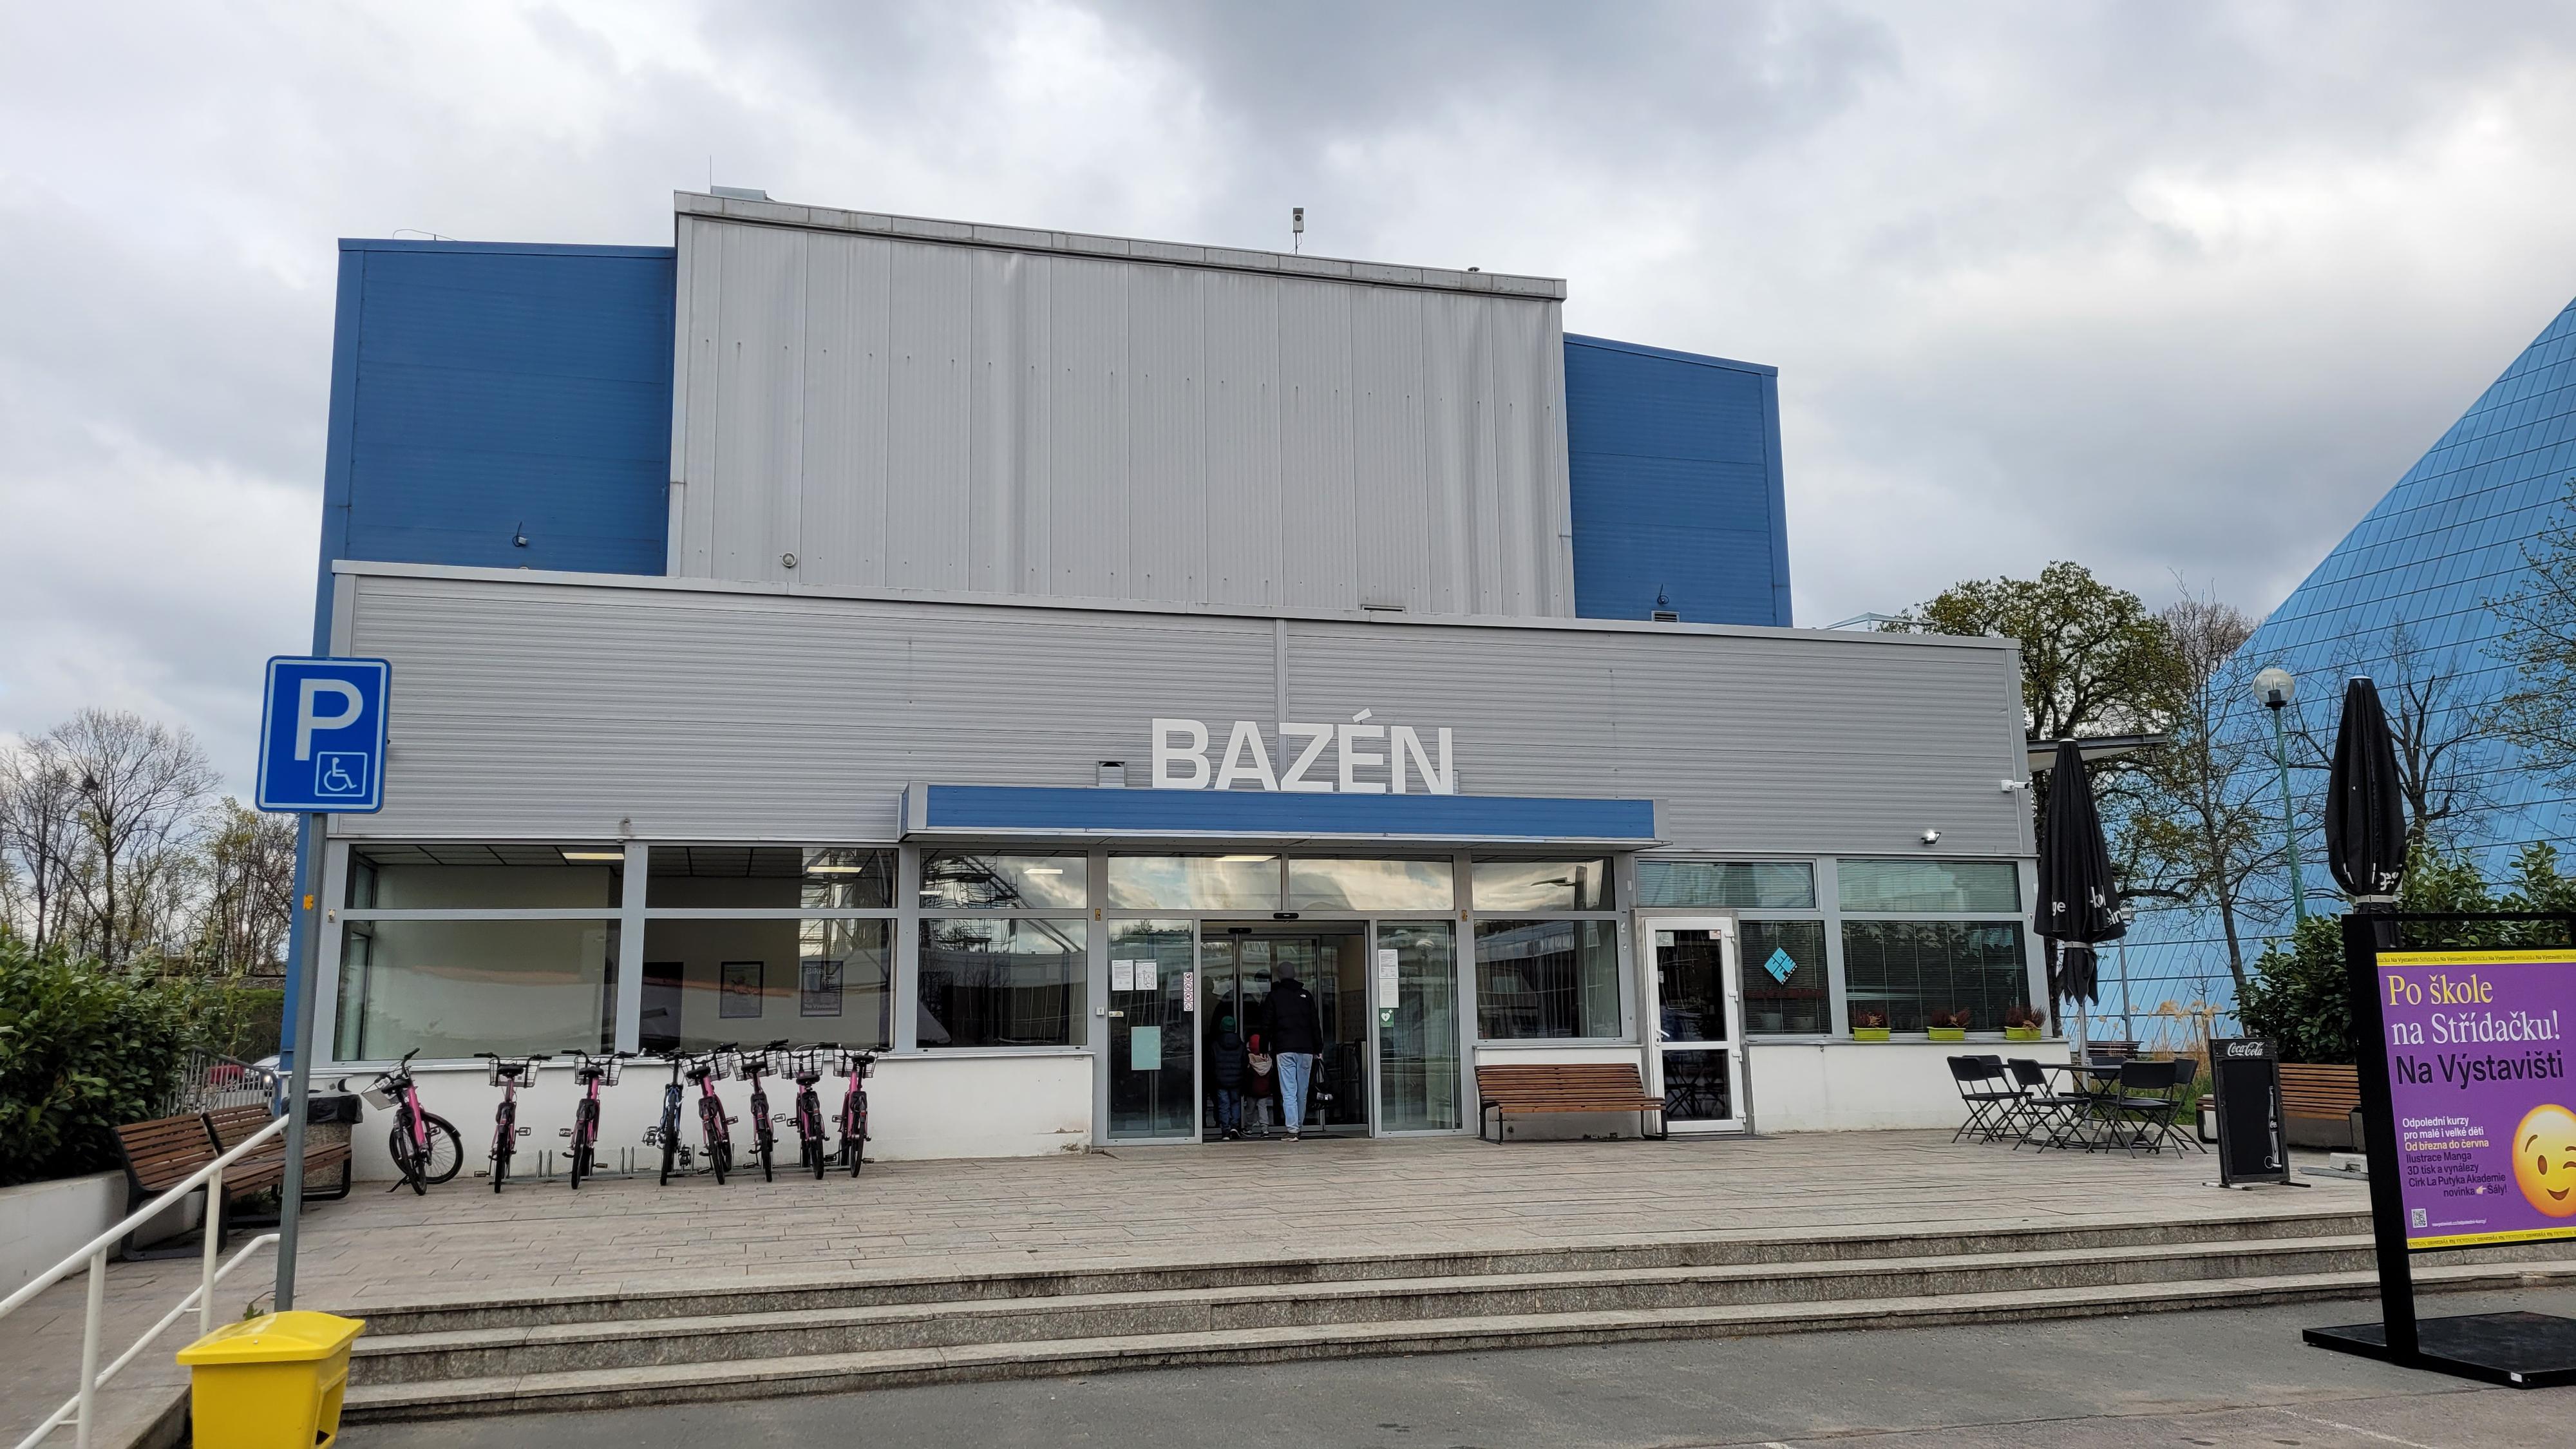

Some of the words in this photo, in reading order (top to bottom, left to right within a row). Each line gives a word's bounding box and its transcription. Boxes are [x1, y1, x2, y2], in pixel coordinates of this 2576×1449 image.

[294, 678, 363, 761] P
[1152, 708, 1453, 795] BAZÉN
[2386, 975, 2421, 1005] Po
[2429, 974, 2493, 1004] škole
[2391, 1022, 2425, 1045] na
[2432, 1010, 2560, 1044] Střídačku!
[2396, 1056, 2433, 1084] Na
[2437, 1050, 2564, 1089] Výstavišti
[2402, 1116, 2445, 1128] Odpolední
[2447, 1116, 2469, 1126] kurzy
[2404, 1132, 2418, 1141] pro
[2420, 1128, 2439, 1139] malé
[2441, 1128, 2444, 1137] i
[2445, 1127, 2467, 1137] velké
[2468, 1126, 2484, 1136] děti
[2405, 1142, 2417, 1151] Od
[2420, 1141, 2447, 1150] března
[2449, 1140, 2459, 1149] do
[2461, 1139, 2489, 1148] června
[2406, 1153, 2441, 1163] Ilustrace
[2444, 1152, 2472, 1162] Manga
[2407, 1166, 2419, 1175] 3D
[2421, 1165, 2436, 1174] tisk
[2444, 1163, 2479, 1175] vynálezy
[2409, 1178, 2425, 1187] Cirk
[2427, 1177, 2436, 1186] La
[2438, 1175, 2465, 1187] Putyka
[2467, 1173, 2505, 1184] Akademie
[2443, 1187, 2475, 1197] novinka
[2487, 1184, 2507, 1196] Šály!
